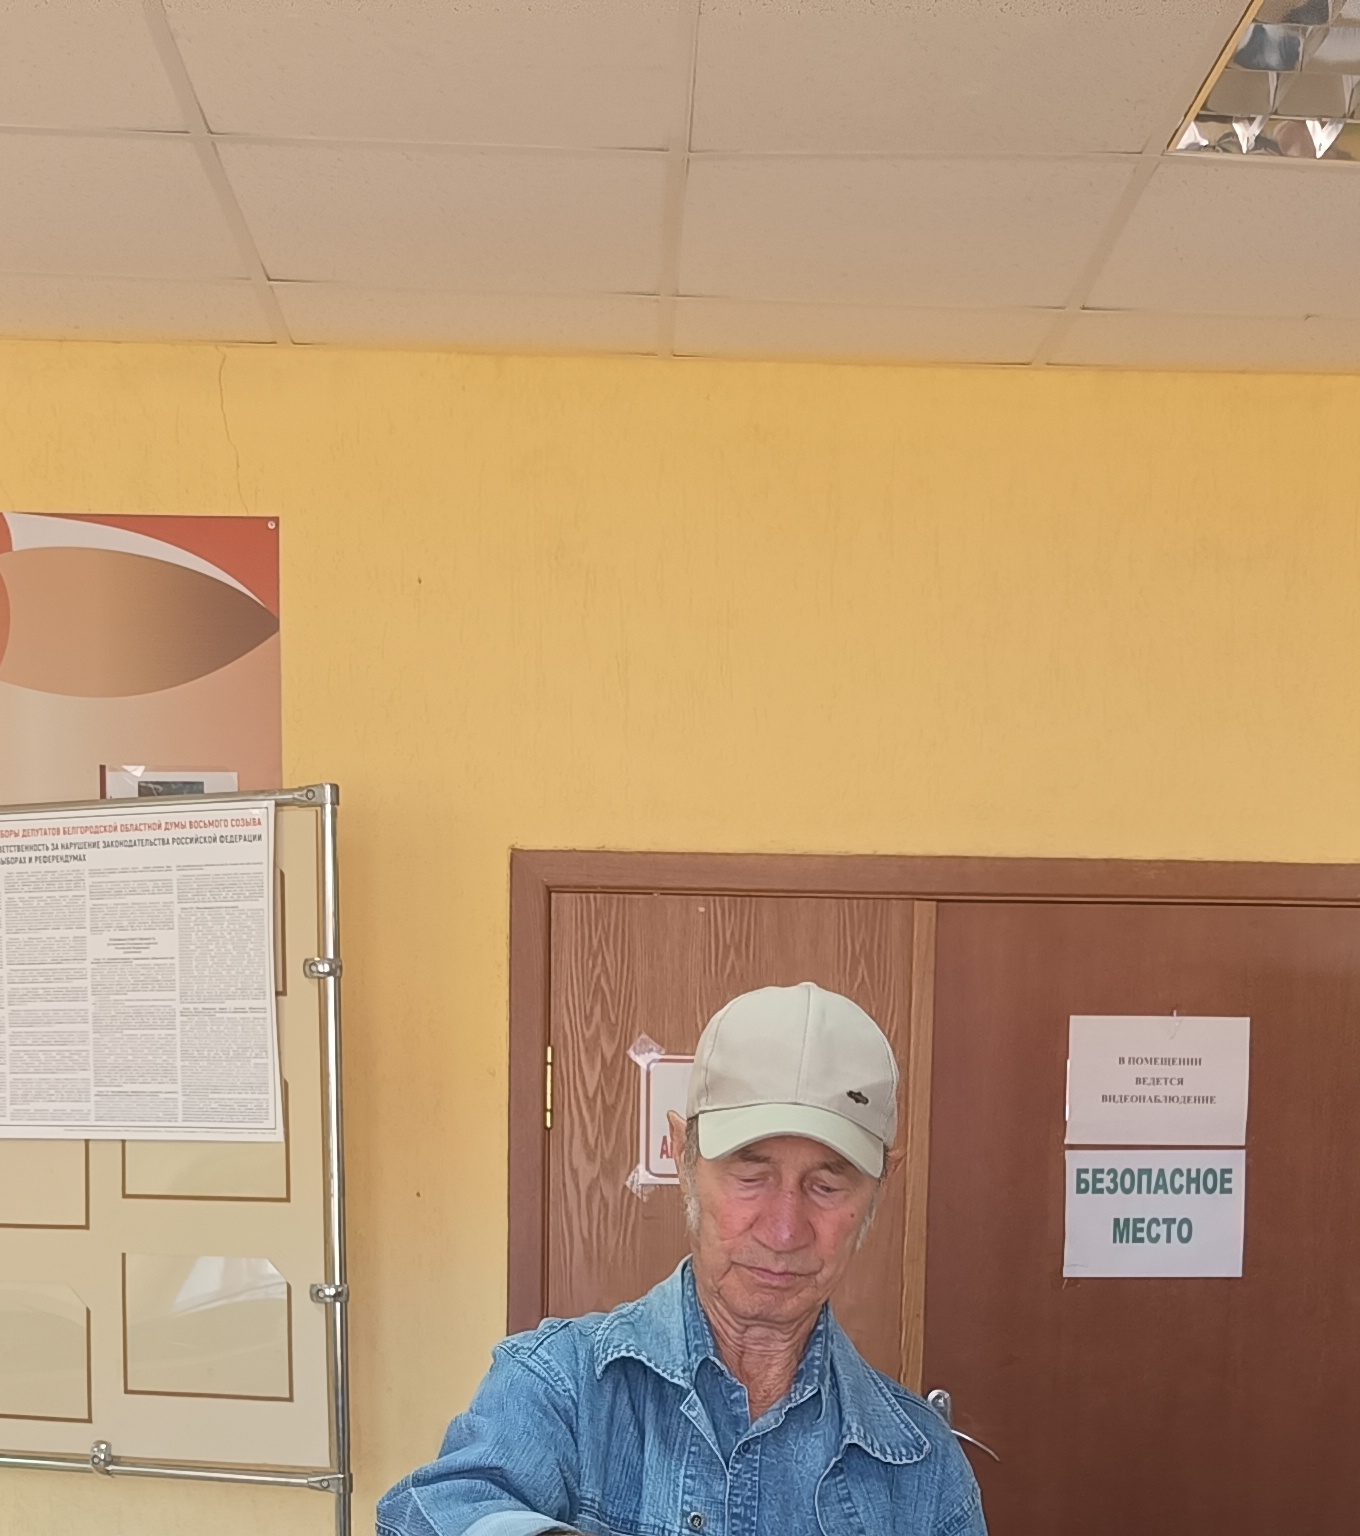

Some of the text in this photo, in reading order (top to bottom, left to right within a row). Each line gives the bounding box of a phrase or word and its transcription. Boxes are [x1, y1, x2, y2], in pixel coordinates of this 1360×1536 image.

[21, 827, 60, 838] ДЕПУТАТОВ
[62, 822, 119, 835] БЕЛГОРОДСКОЙ
[120, 820, 162, 832] ОБЛАСТНОЙ
[164, 820, 187, 831] ДУМЫ
[189, 818, 229, 830] ВОСЬМОГО
[230, 817, 262, 827] СОЗЫВА
[51, 842, 59, 851] ЗА
[61, 840, 101, 850] НАРУШЕНИЕ
[102, 836, 171, 849] ЗАКОНОДАТЕЛЬСТВА
[171, 833, 218, 845] РОССИЙСКОЙ
[219, 833, 263, 844] ФЕДЕРАЦИИ
[28, 855, 33, 864] И
[34, 854, 87, 864] РЕФЕРЕНДУМАХ
[1118, 1056, 1202, 1068] В ПОМЕЩЕНИИ
[1134, 1076, 1185, 1087] ВЕДЕТСЯ
[1101, 1094, 1217, 1105] ВИДЕОНАБЛЮДЕНИЕ
[1075, 1167, 1233, 1195] БЕЗОПАСНОЕ
[1111, 1217, 1194, 1244] МЕСТО
